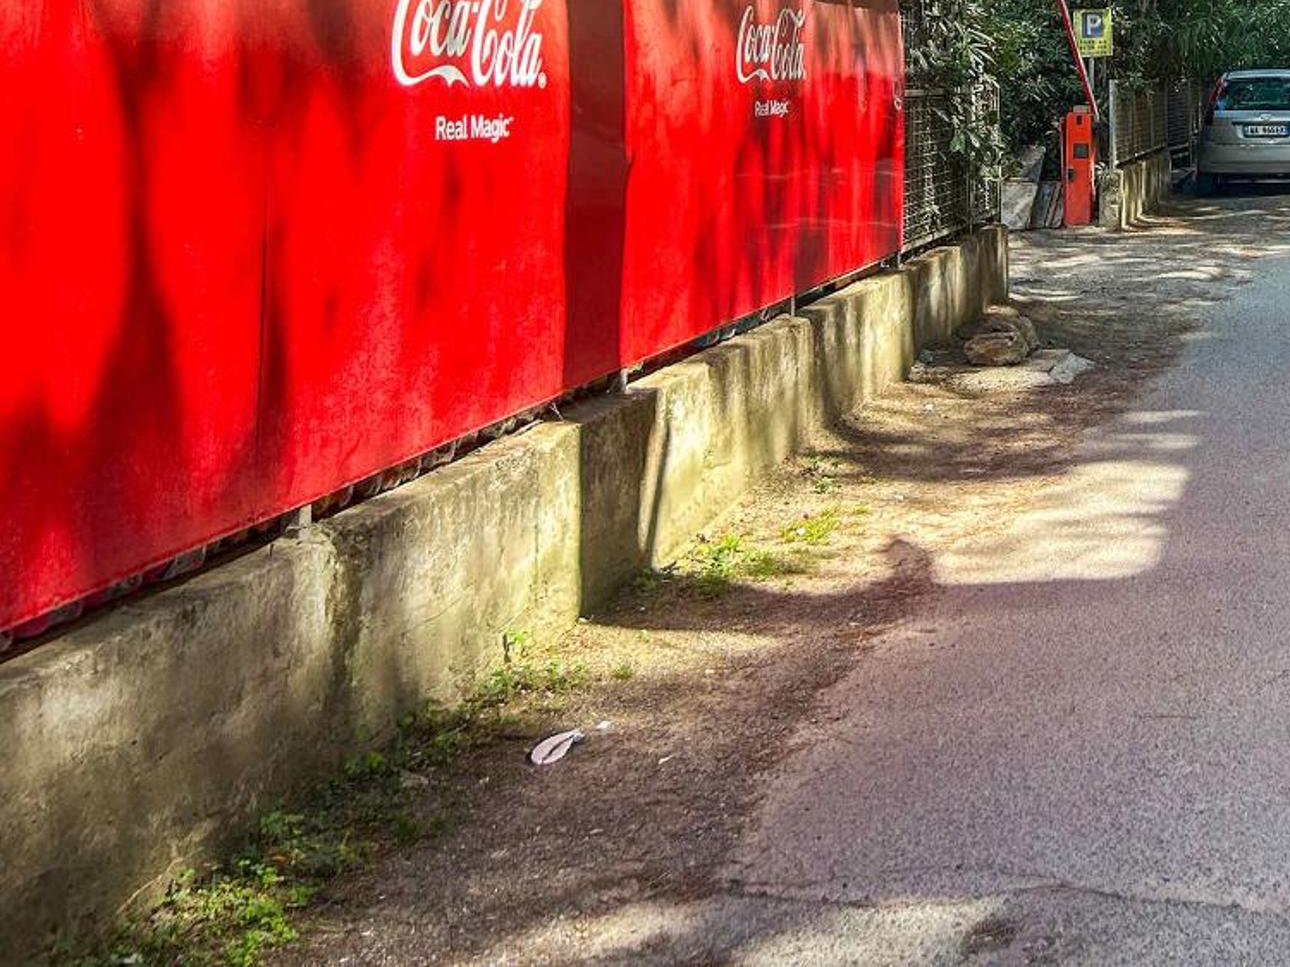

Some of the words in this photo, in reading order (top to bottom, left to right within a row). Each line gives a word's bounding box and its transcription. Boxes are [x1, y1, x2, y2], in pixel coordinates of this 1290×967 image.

[1087, 14, 1102, 35] P
[435, 116, 468, 140] Real
[471, 114, 514, 143] Magic
